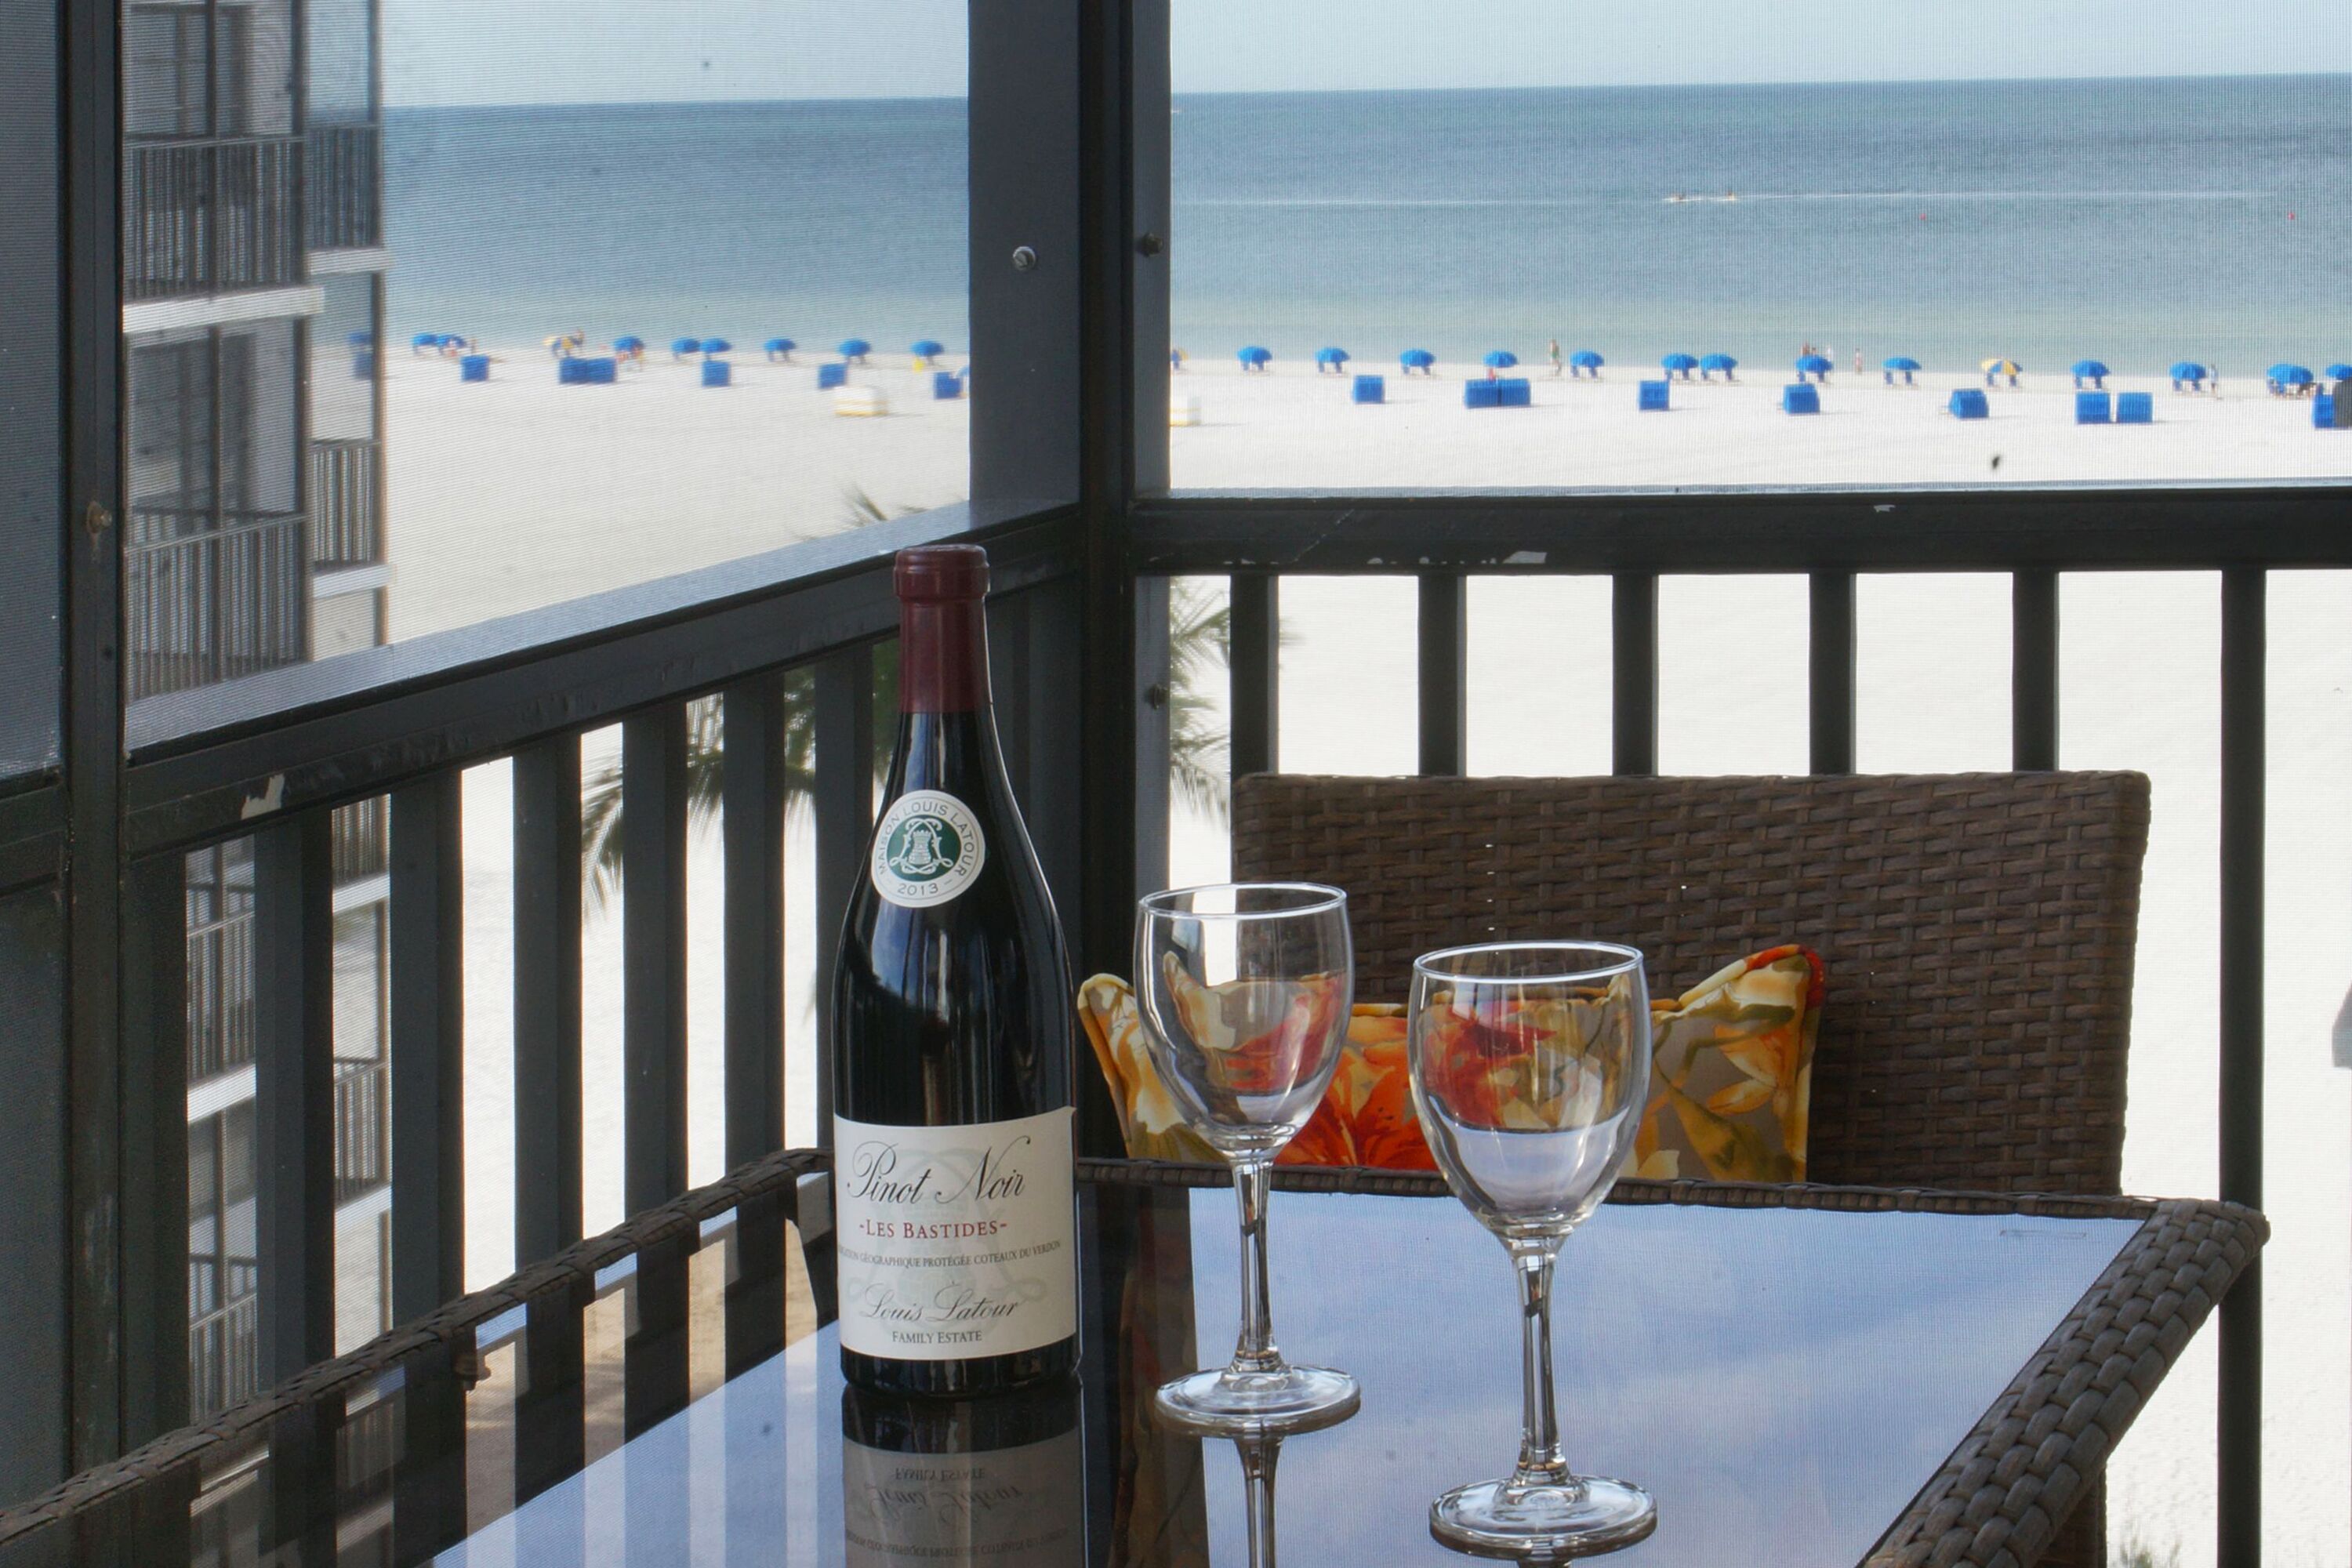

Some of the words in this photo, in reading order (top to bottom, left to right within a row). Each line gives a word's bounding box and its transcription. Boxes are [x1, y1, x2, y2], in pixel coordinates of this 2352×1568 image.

[878, 814, 900, 875] MAISON
[902, 800, 949, 817] LOUIS
[950, 812, 975, 877] LATOUR
[897, 883, 938, 896] 2013
[847, 1141, 931, 1204] Pinot
[935, 1135, 1030, 1204] Noir
[859, 1283, 924, 1321] Louis
[925, 1281, 1019, 1322] Latour
[892, 1331, 935, 1344] FAMILY
[938, 1330, 982, 1344] ESTATE
